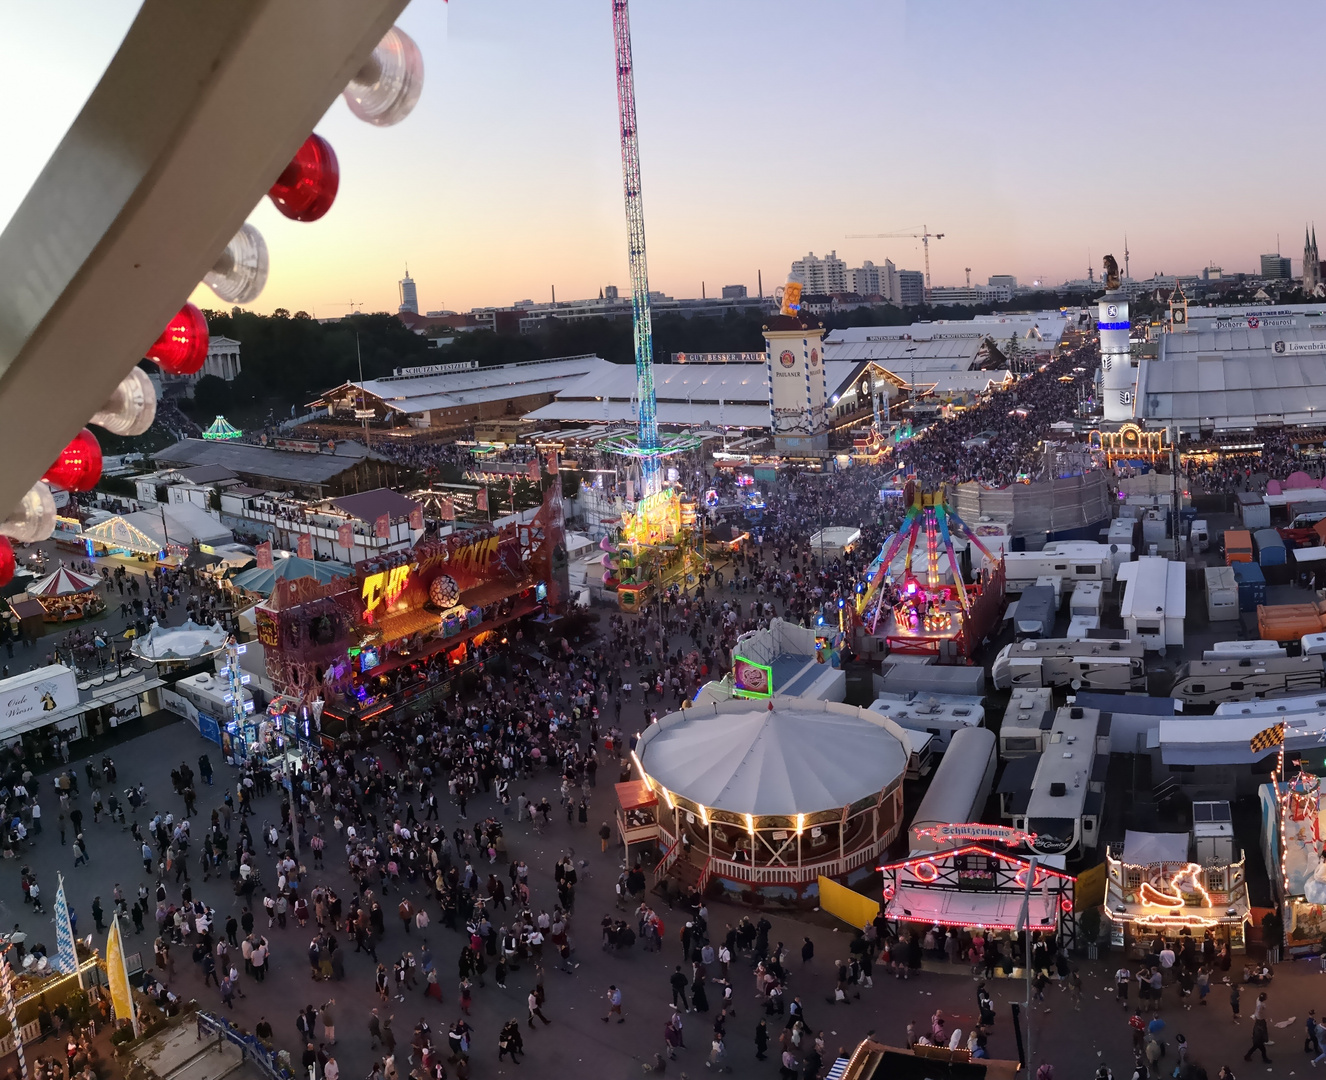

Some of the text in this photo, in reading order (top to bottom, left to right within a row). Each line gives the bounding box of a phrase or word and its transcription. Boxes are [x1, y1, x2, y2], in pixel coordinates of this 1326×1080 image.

[707, 353, 738, 361] BESSER,
[7, 694, 28, 708] Oide
[941, 826, 1011, 838] Schützenhaus
